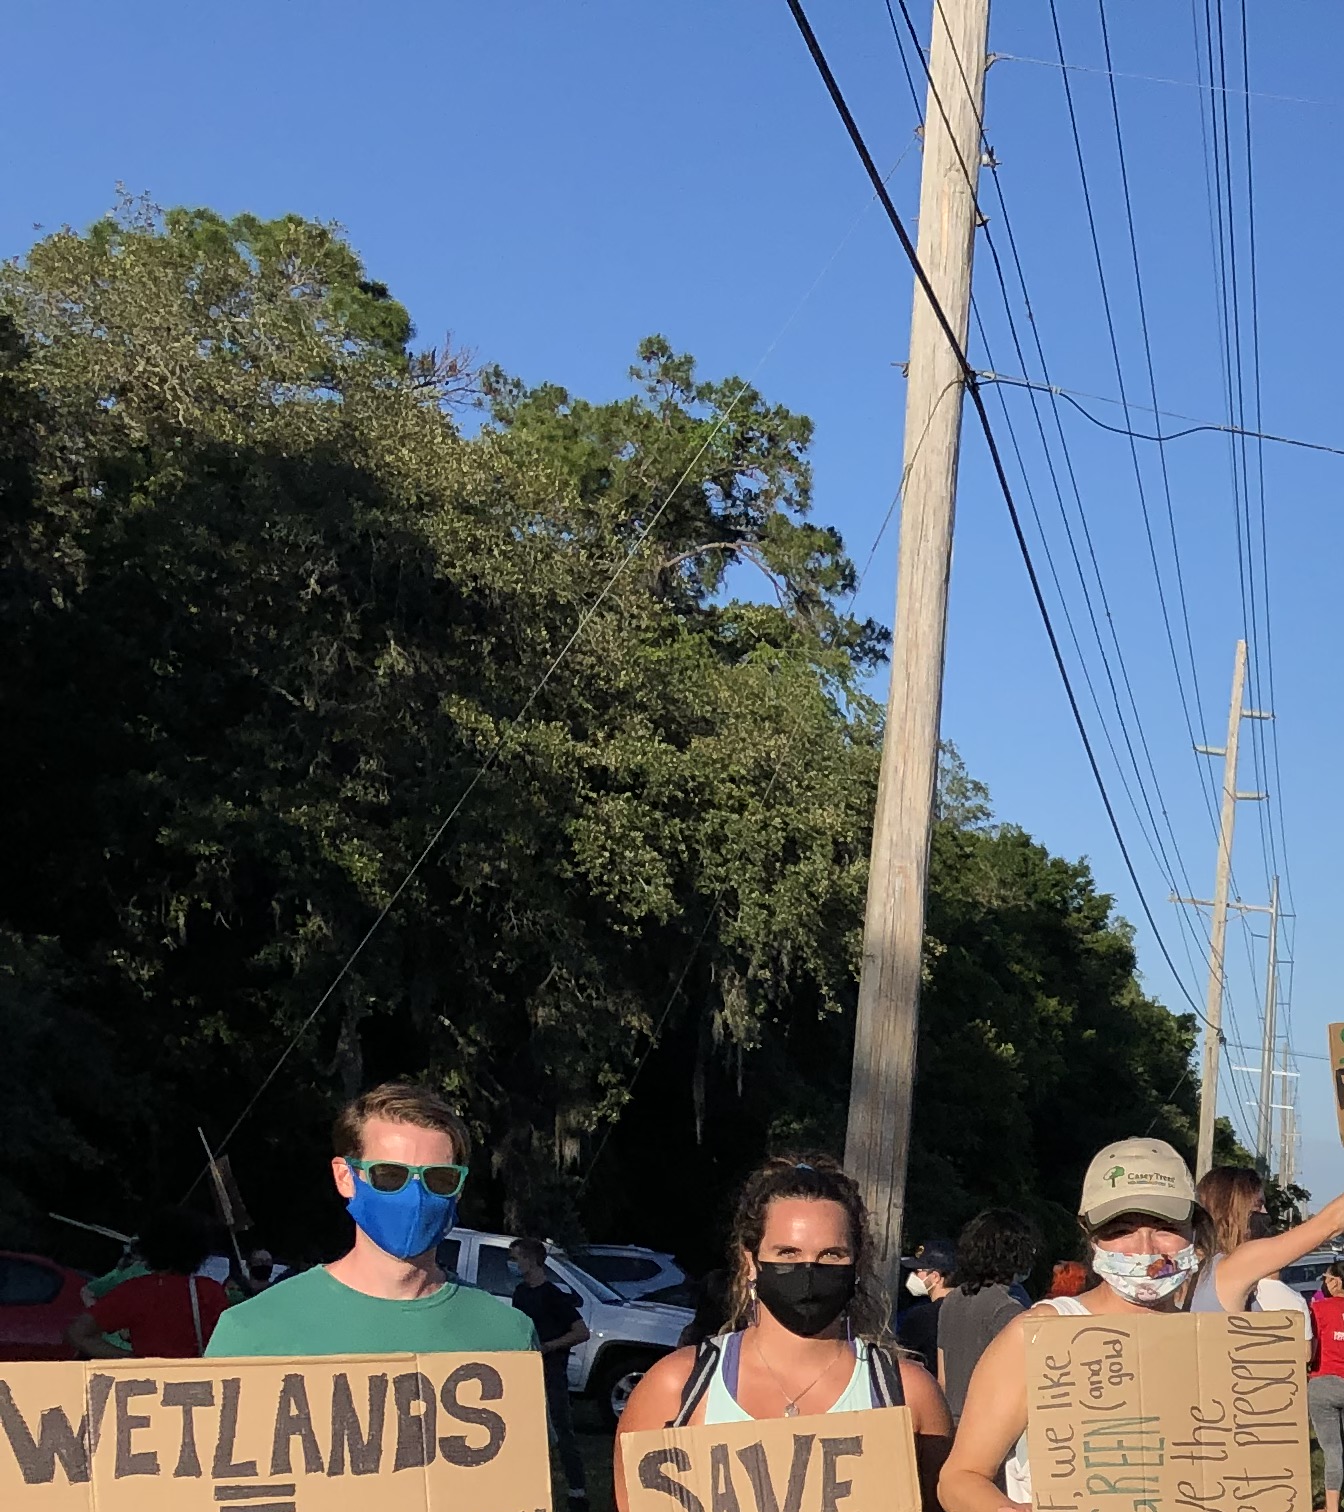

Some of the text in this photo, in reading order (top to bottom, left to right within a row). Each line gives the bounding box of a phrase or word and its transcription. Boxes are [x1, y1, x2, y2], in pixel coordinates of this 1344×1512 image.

[1036, 1350, 1076, 1410] like
[1227, 1315, 1300, 1448] preserve
[0, 1361, 506, 1485] WETLANDS
[1045, 1423, 1077, 1478] we
[1170, 1399, 1232, 1465] the
